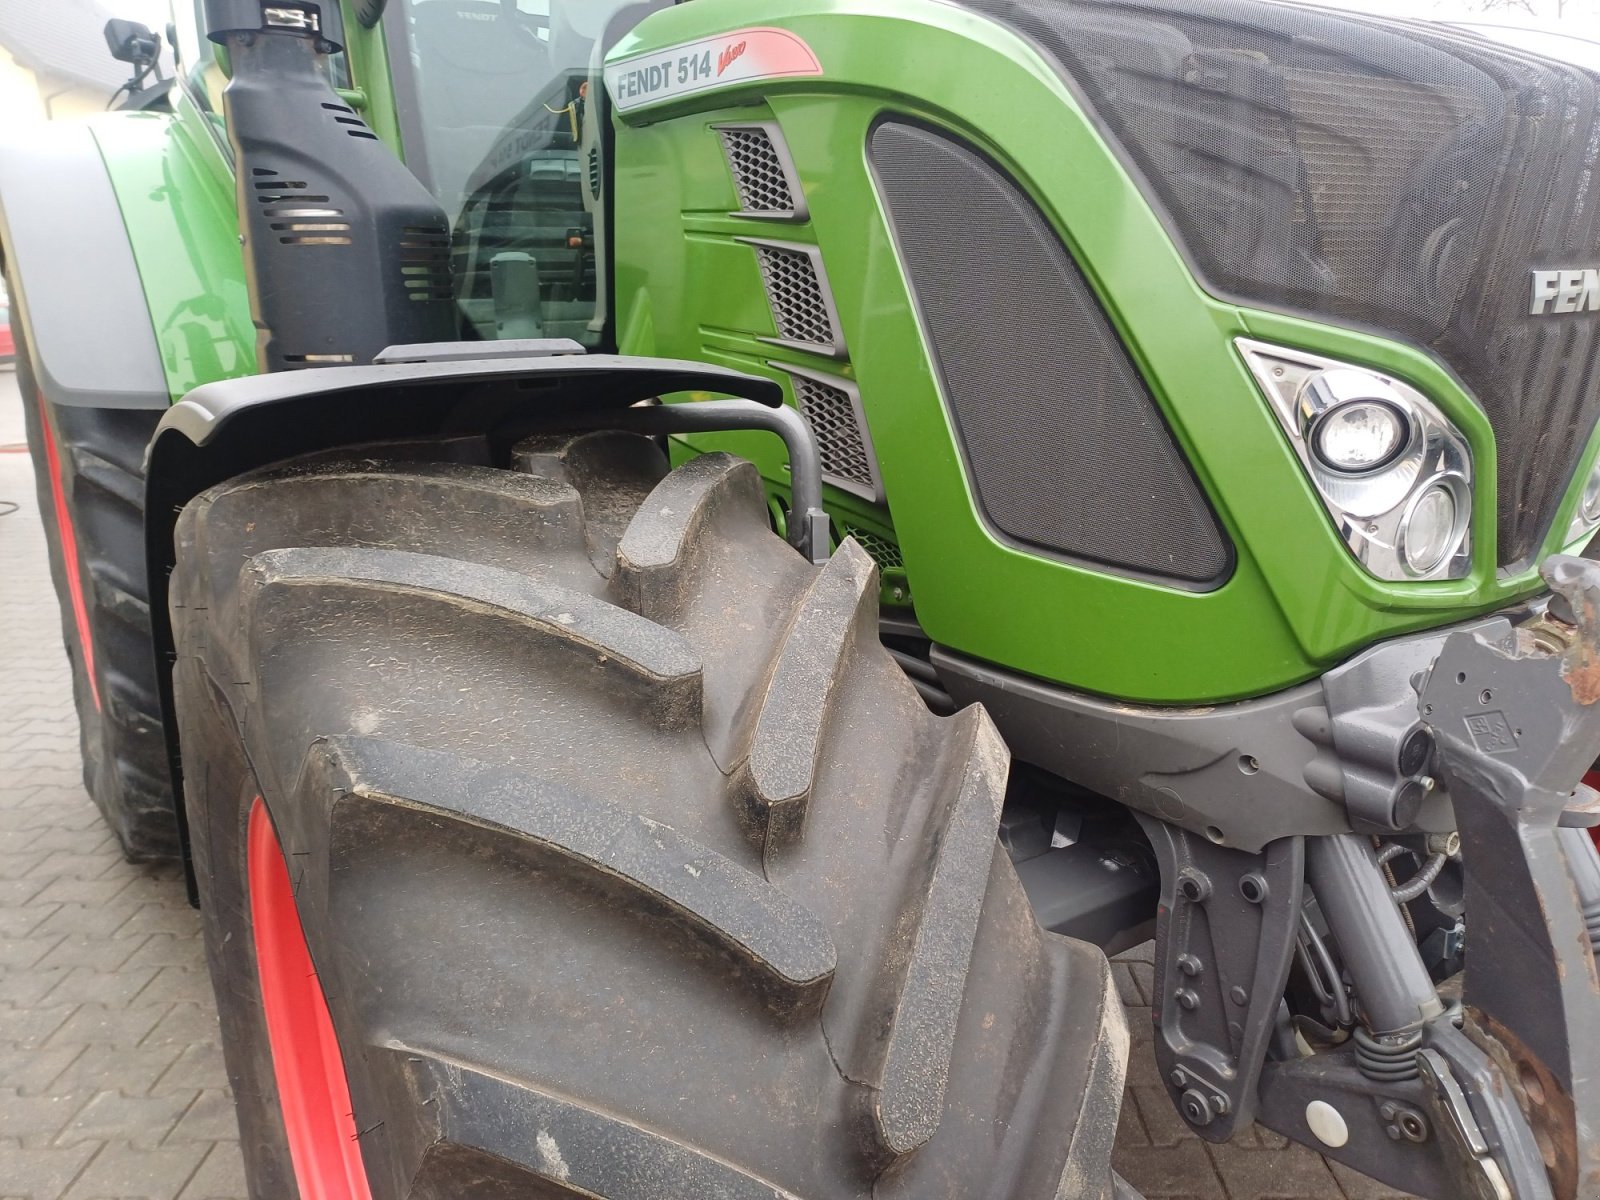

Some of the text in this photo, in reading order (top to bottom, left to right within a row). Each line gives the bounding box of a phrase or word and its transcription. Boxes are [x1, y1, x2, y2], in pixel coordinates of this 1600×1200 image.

[618, 61, 672, 100] FENDT
[677, 50, 711, 85] 514
[1529, 269, 1600, 315] FEN
